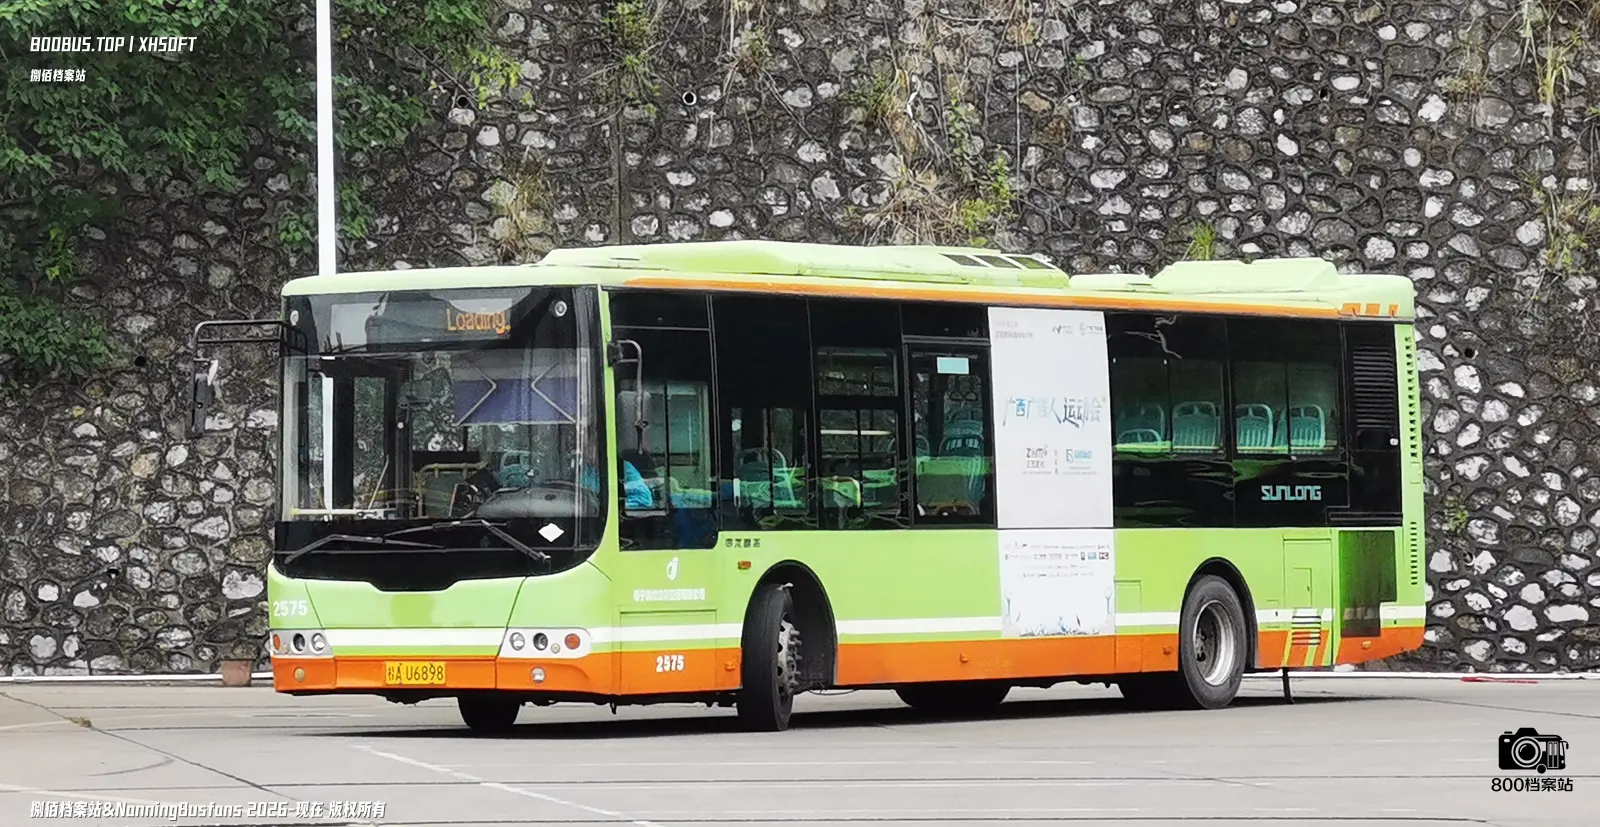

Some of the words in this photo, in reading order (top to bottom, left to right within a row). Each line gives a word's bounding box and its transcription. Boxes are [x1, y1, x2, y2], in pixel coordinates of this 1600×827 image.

[1261, 485, 1322, 500] SUNLONG
[272, 600, 308, 616] 2575
[656, 654, 685, 673] 2575
